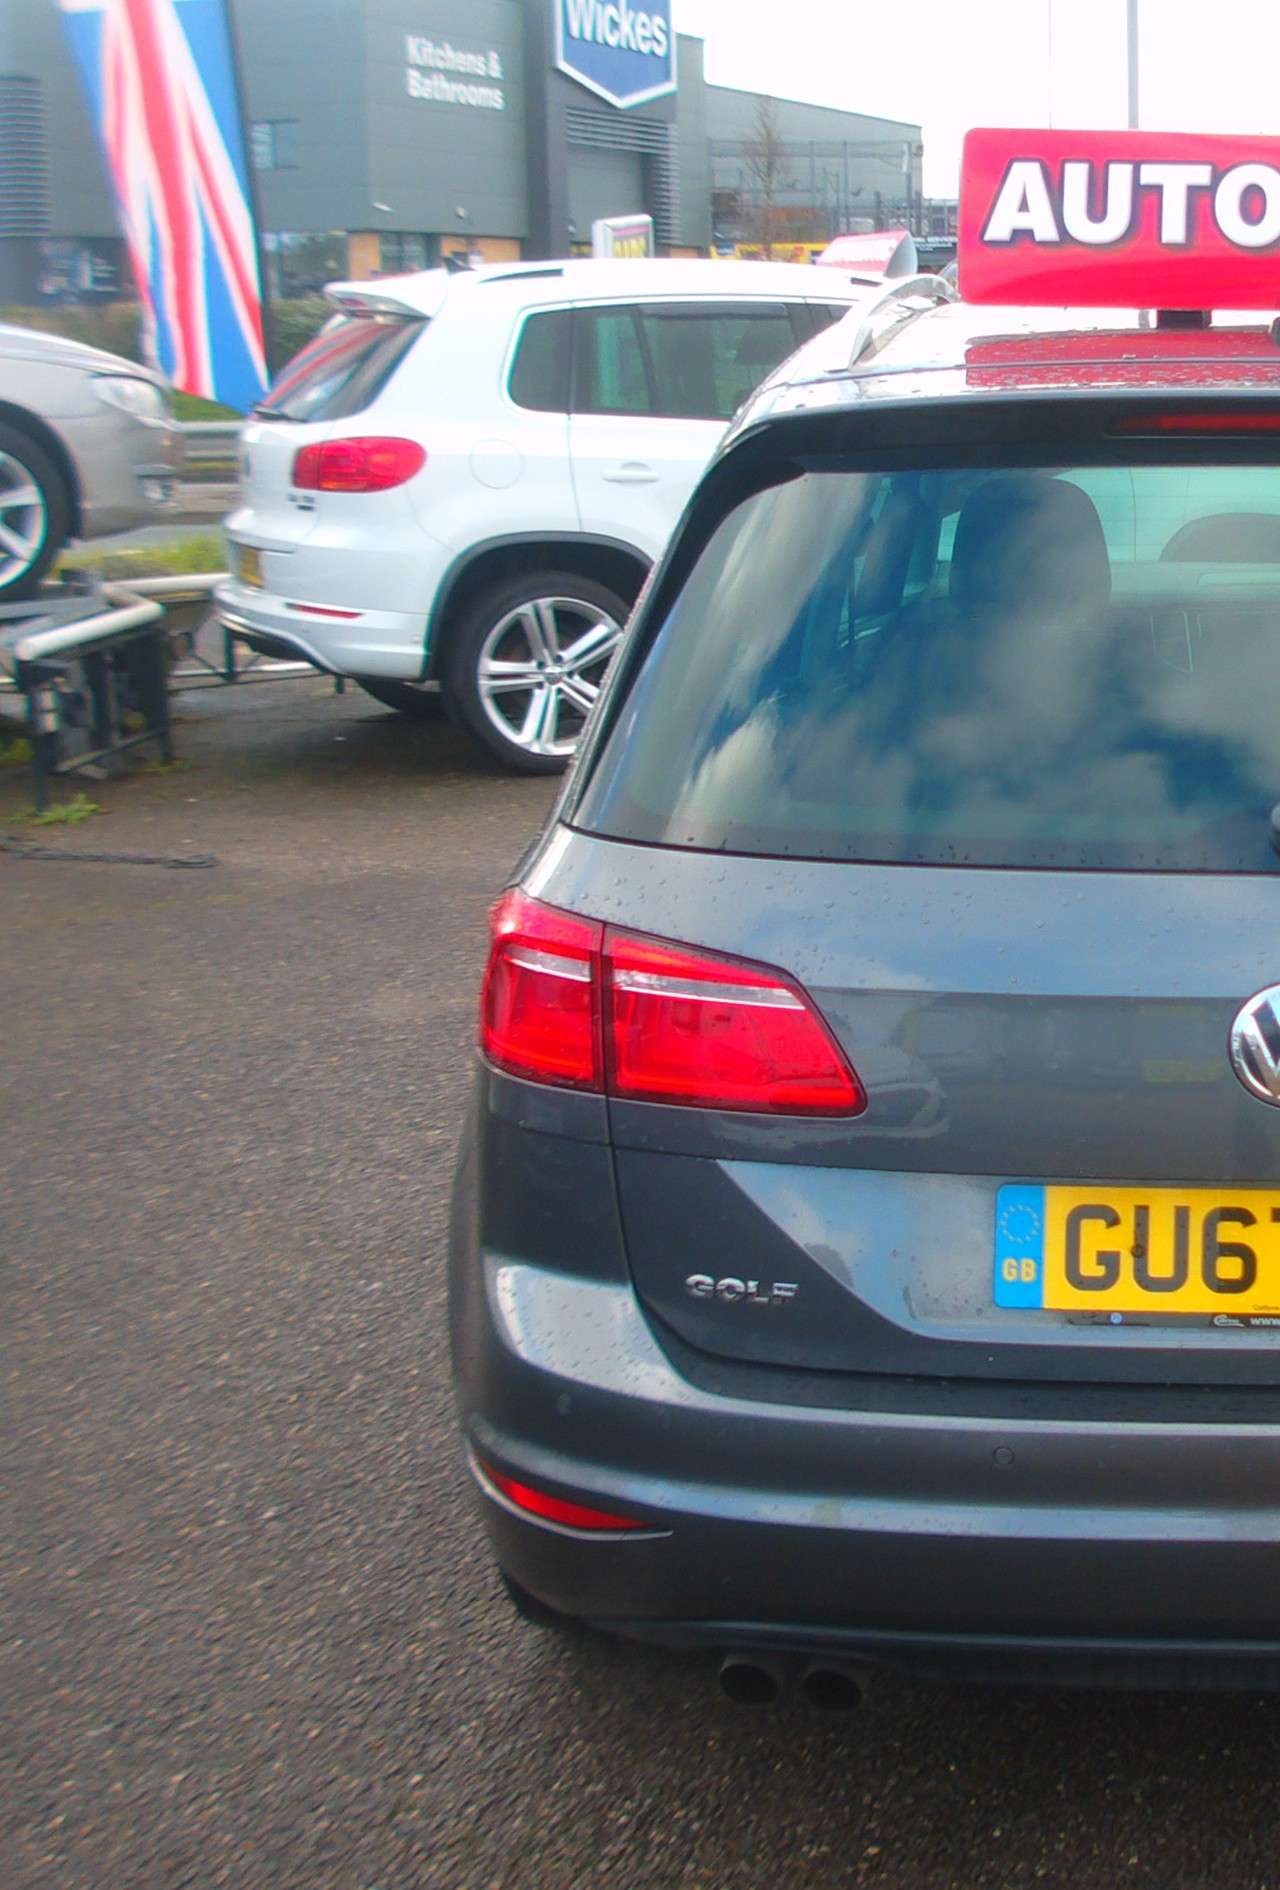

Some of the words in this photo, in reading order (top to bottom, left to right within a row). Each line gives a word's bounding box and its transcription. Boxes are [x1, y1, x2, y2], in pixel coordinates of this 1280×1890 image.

[566, 0, 669, 57] Wickes
[407, 35, 486, 75] Kitchens
[487, 50, 503, 79] &
[407, 67, 504, 110] Bathrooms
[685, 1273, 799, 1304] GOLF
[1003, 1258, 1037, 1282] GB
